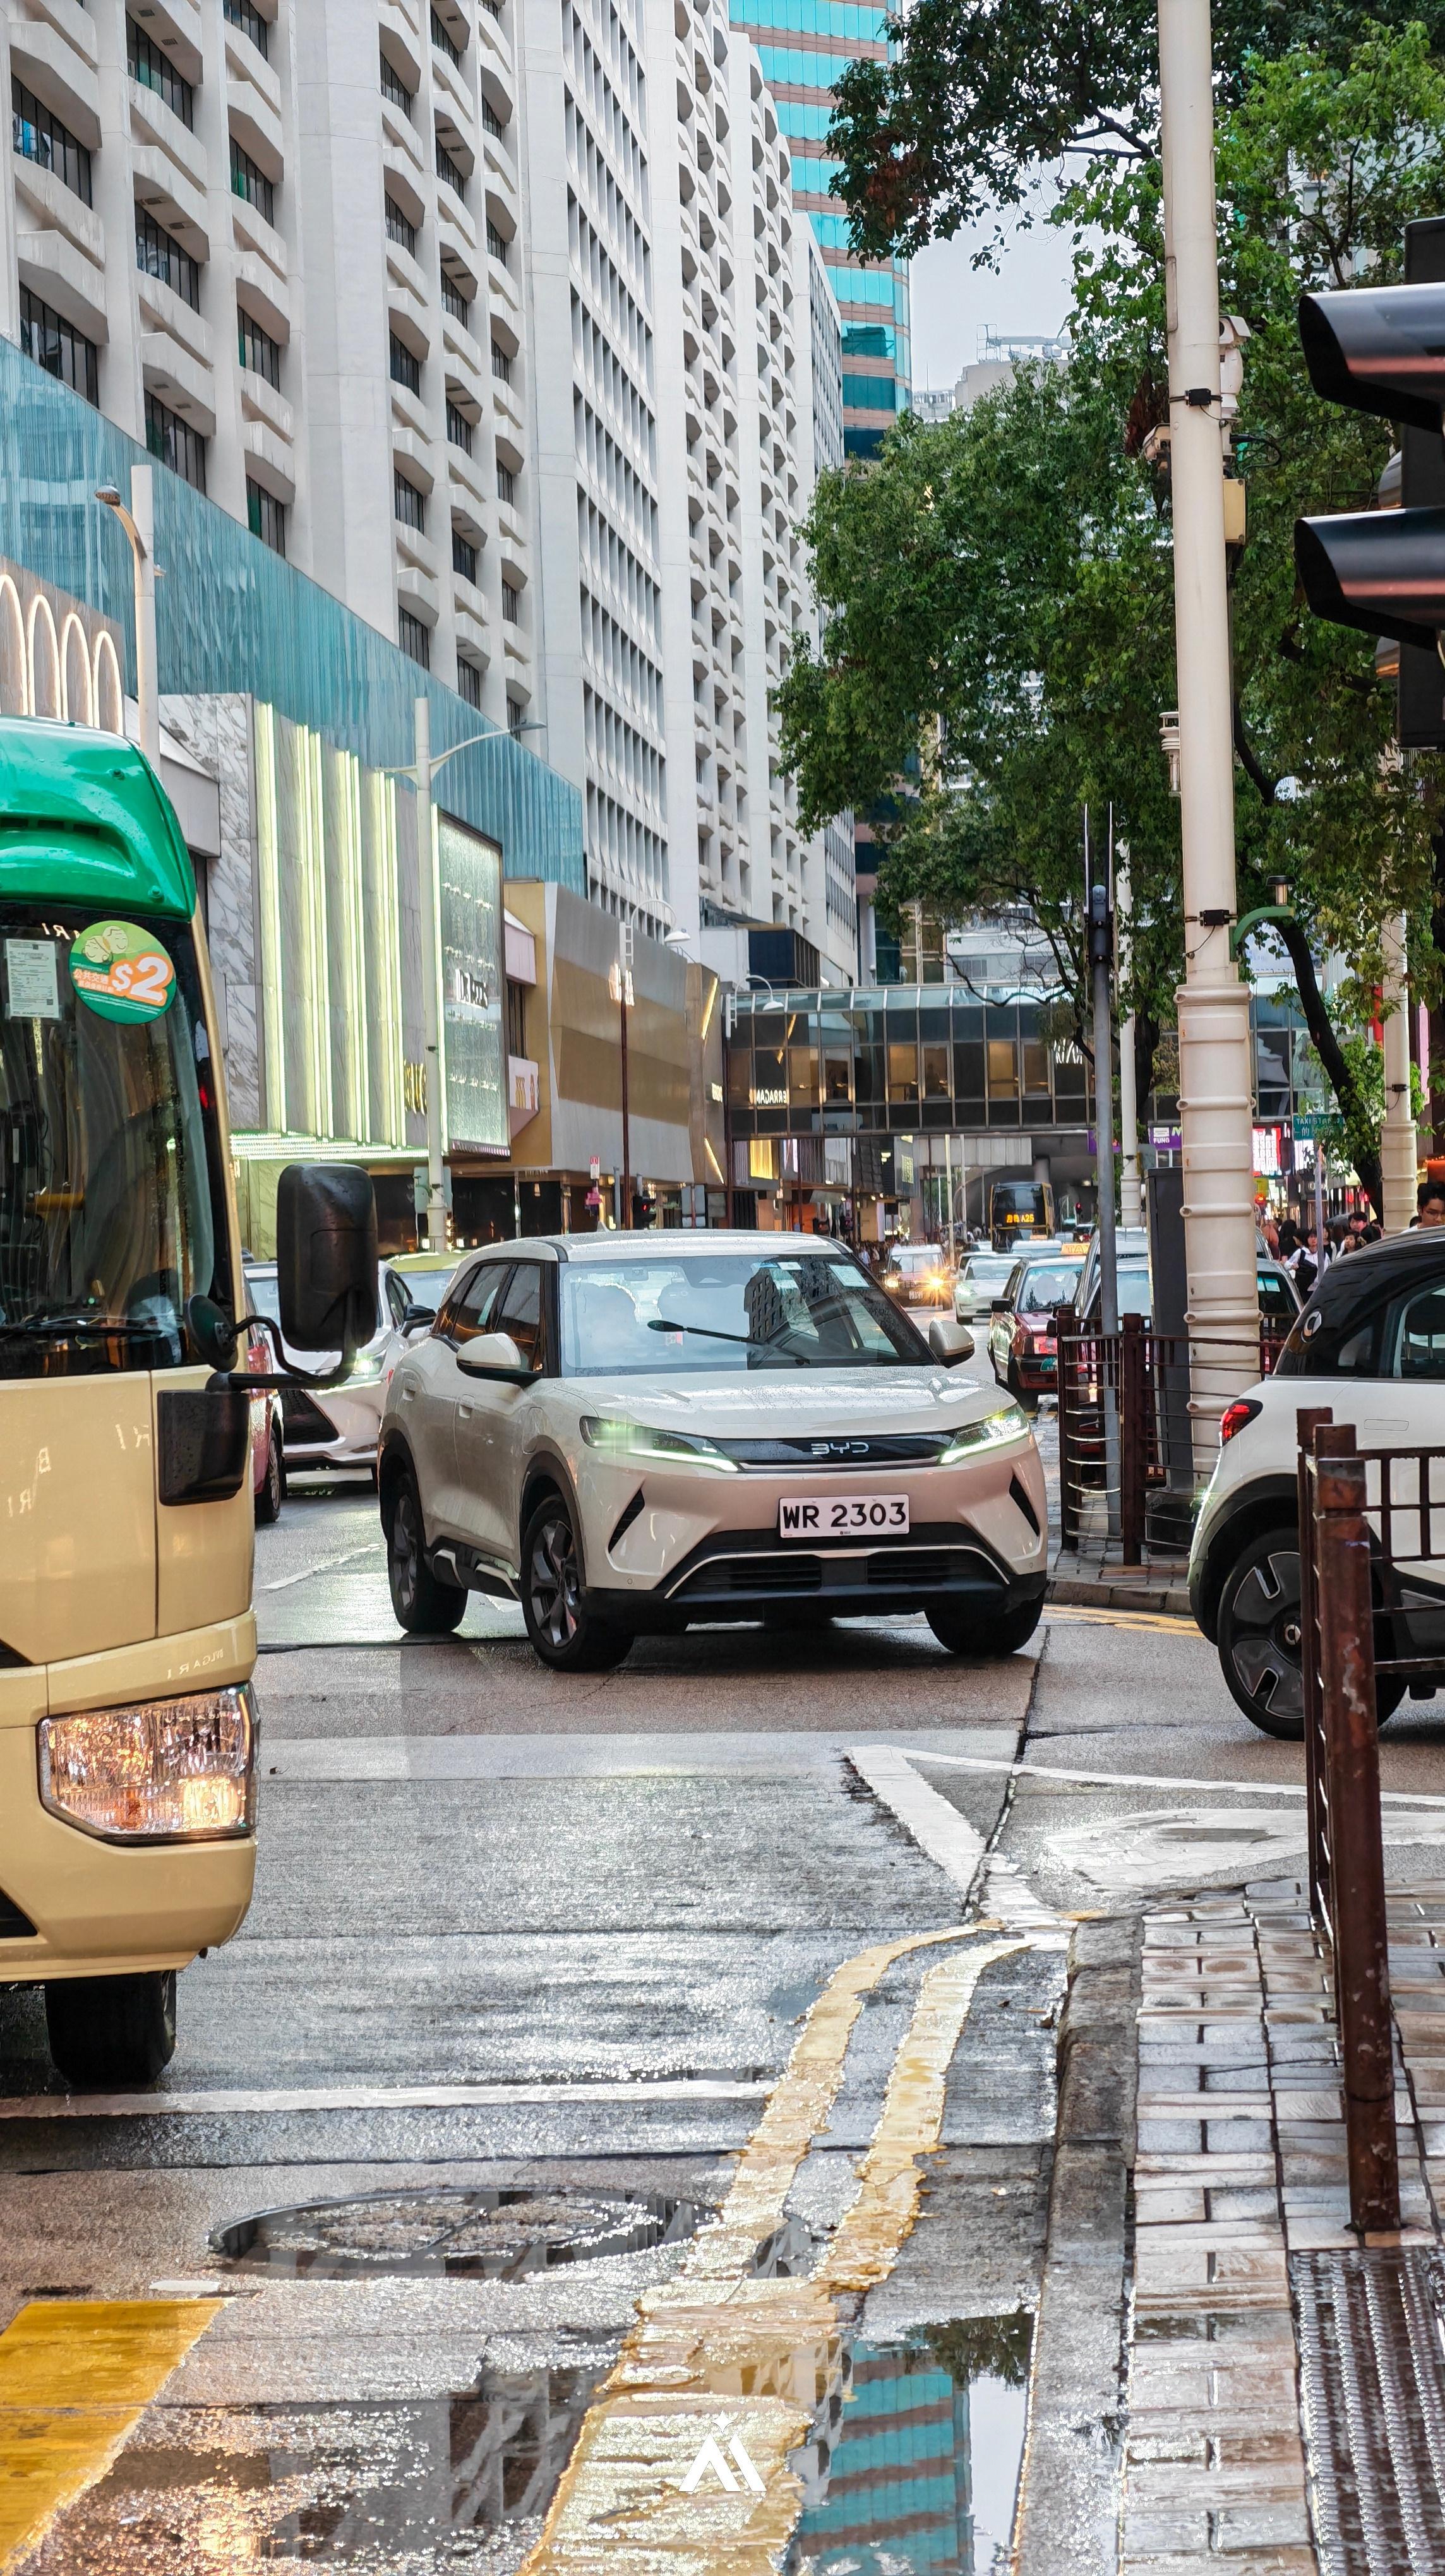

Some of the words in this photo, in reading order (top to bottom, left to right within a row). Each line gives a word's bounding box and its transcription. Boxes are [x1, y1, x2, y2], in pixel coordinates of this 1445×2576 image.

[112, 957, 168, 1002] $2
[811, 1442, 869, 1455] BYD
[782, 1505, 820, 1529] WR
[830, 1502, 906, 1527] 2303
